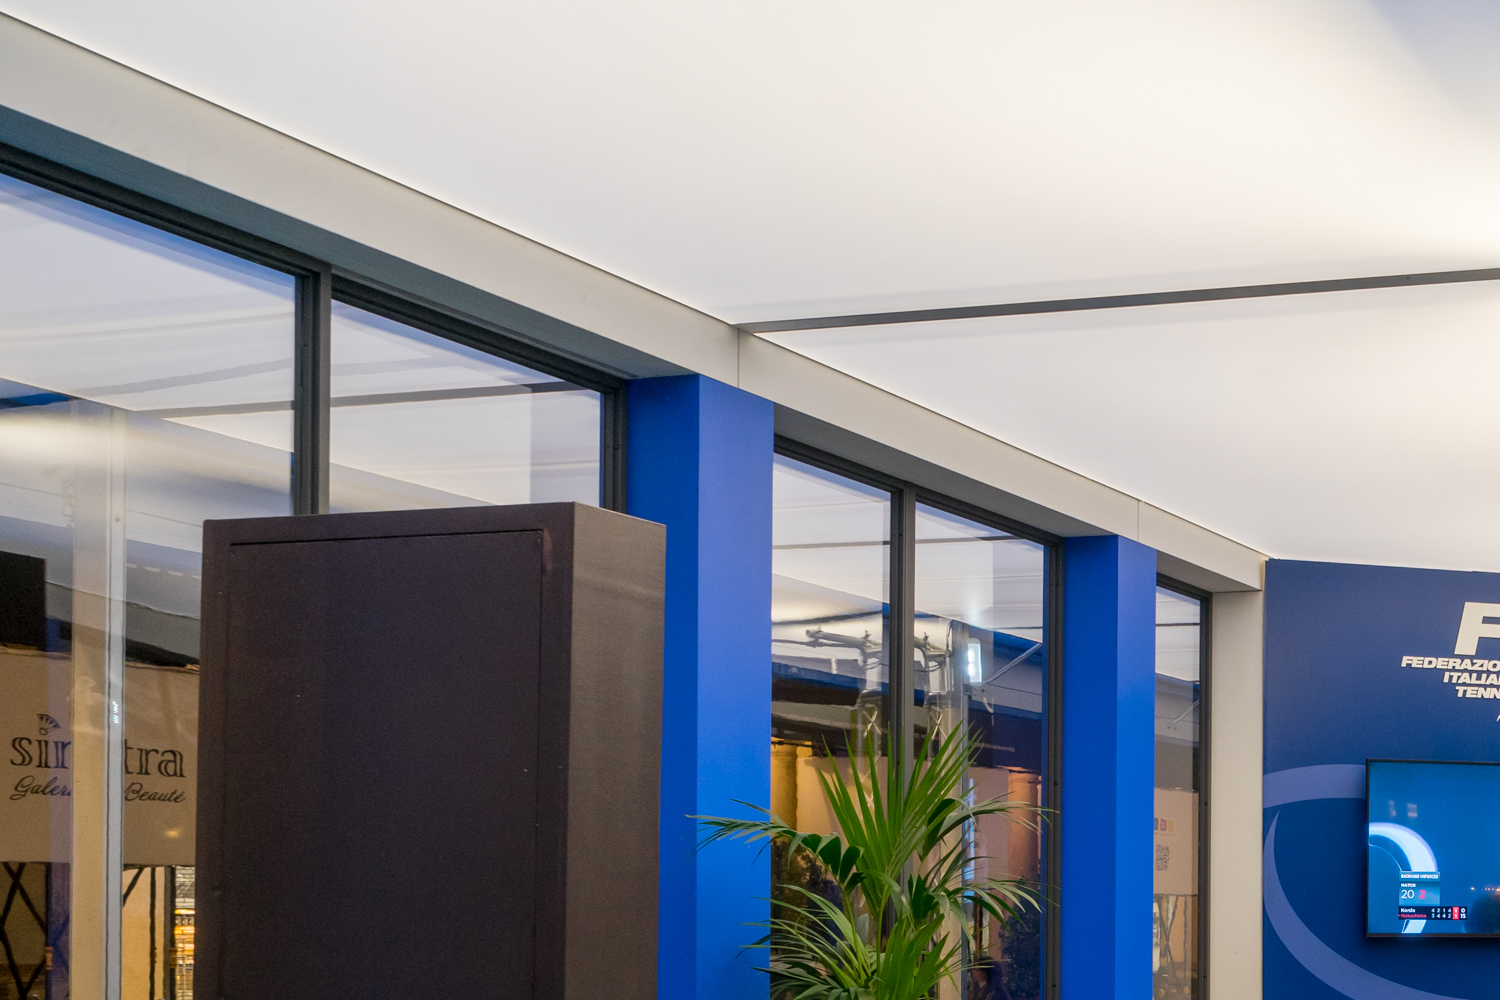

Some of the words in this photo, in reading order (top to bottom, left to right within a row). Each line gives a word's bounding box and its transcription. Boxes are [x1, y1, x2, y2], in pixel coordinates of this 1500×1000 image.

[123, 782, 187, 804] Beauté
[1401, 889, 1415, 899] 20
[1419, 889, 1426, 899] 2
